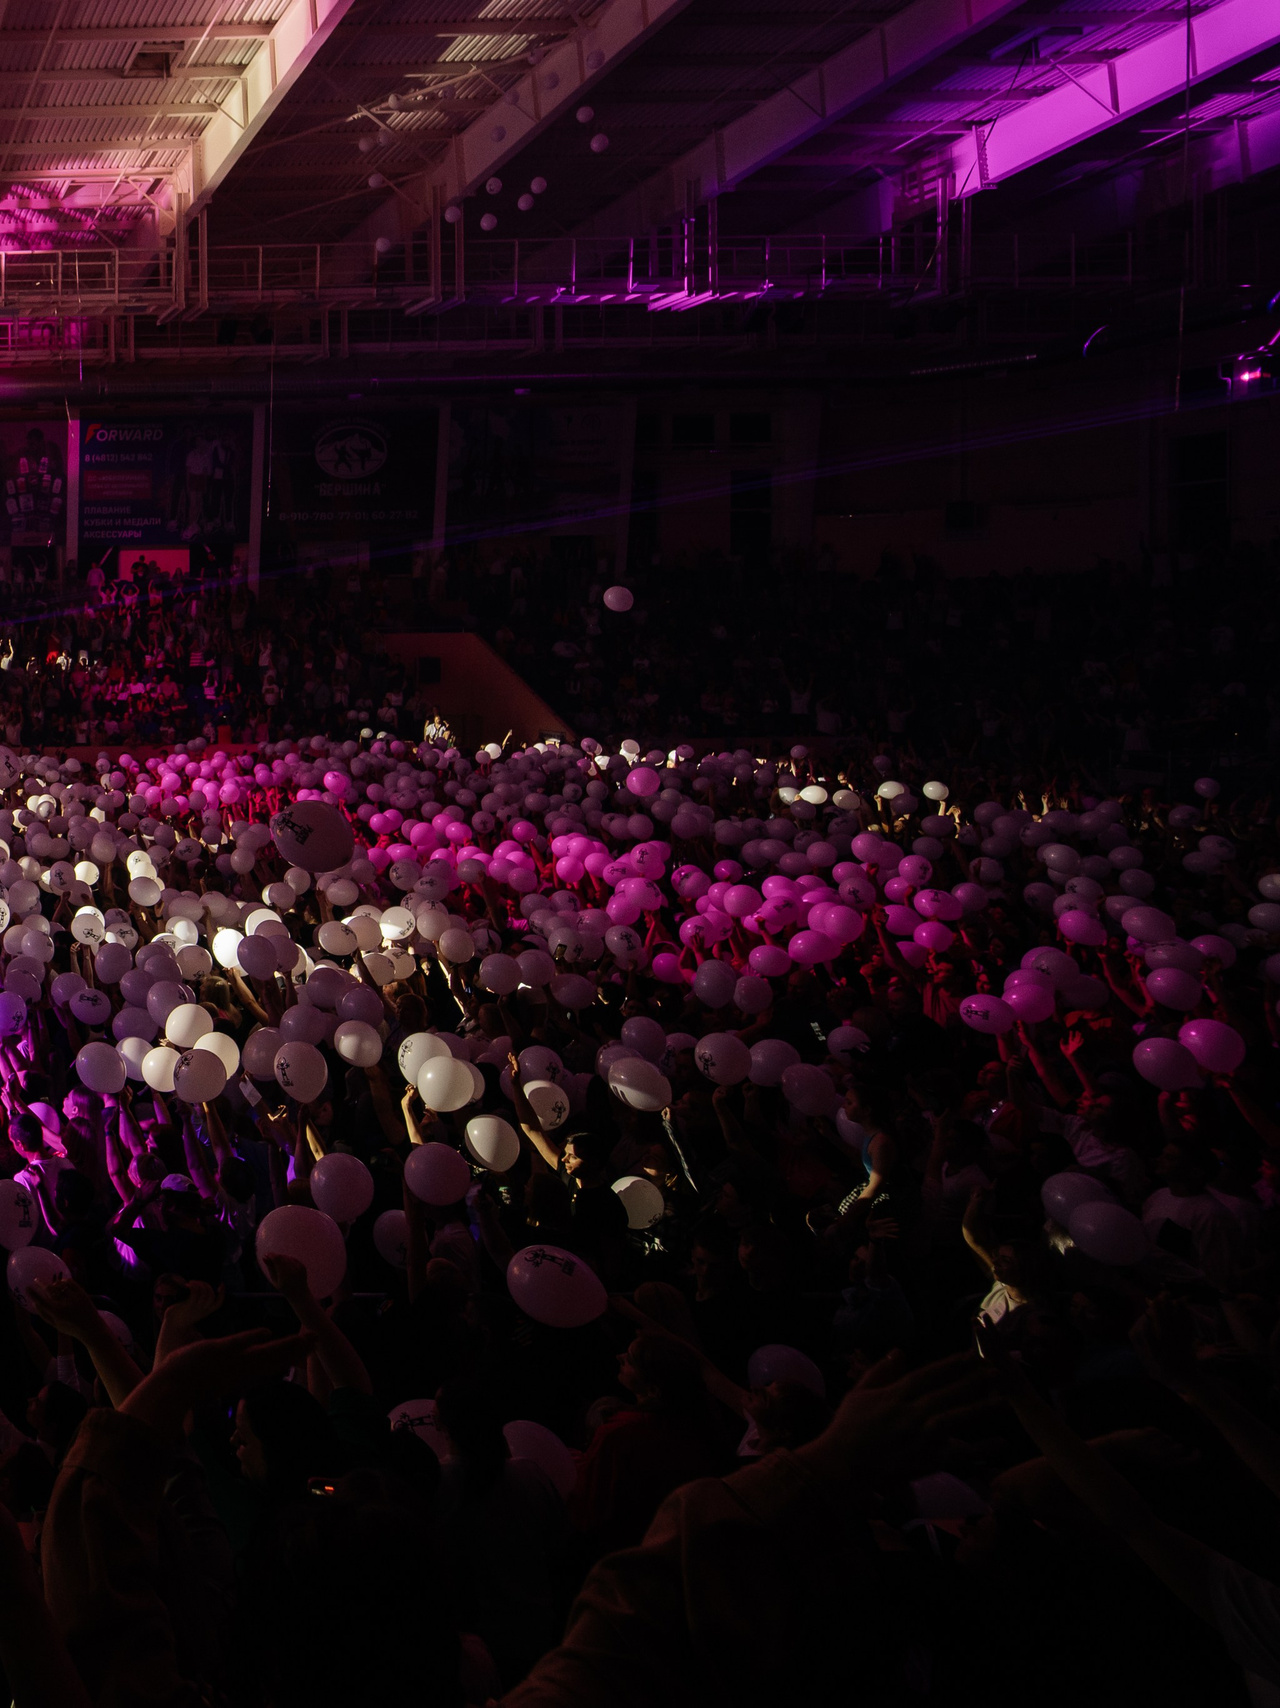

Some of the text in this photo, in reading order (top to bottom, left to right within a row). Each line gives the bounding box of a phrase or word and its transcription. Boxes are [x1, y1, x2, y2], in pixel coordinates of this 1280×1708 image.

[84, 423, 164, 444] FORWARD
[84, 454, 91, 463] 8
[92, 453, 119, 464] (4812)
[84, 505, 131, 515] ПЛАВАНИЕ
[83, 518, 113, 527] КУБКИ
[123, 517, 161, 527] МЕДАЛИ
[83, 530, 142, 538] АКСЕССУАРЫ
